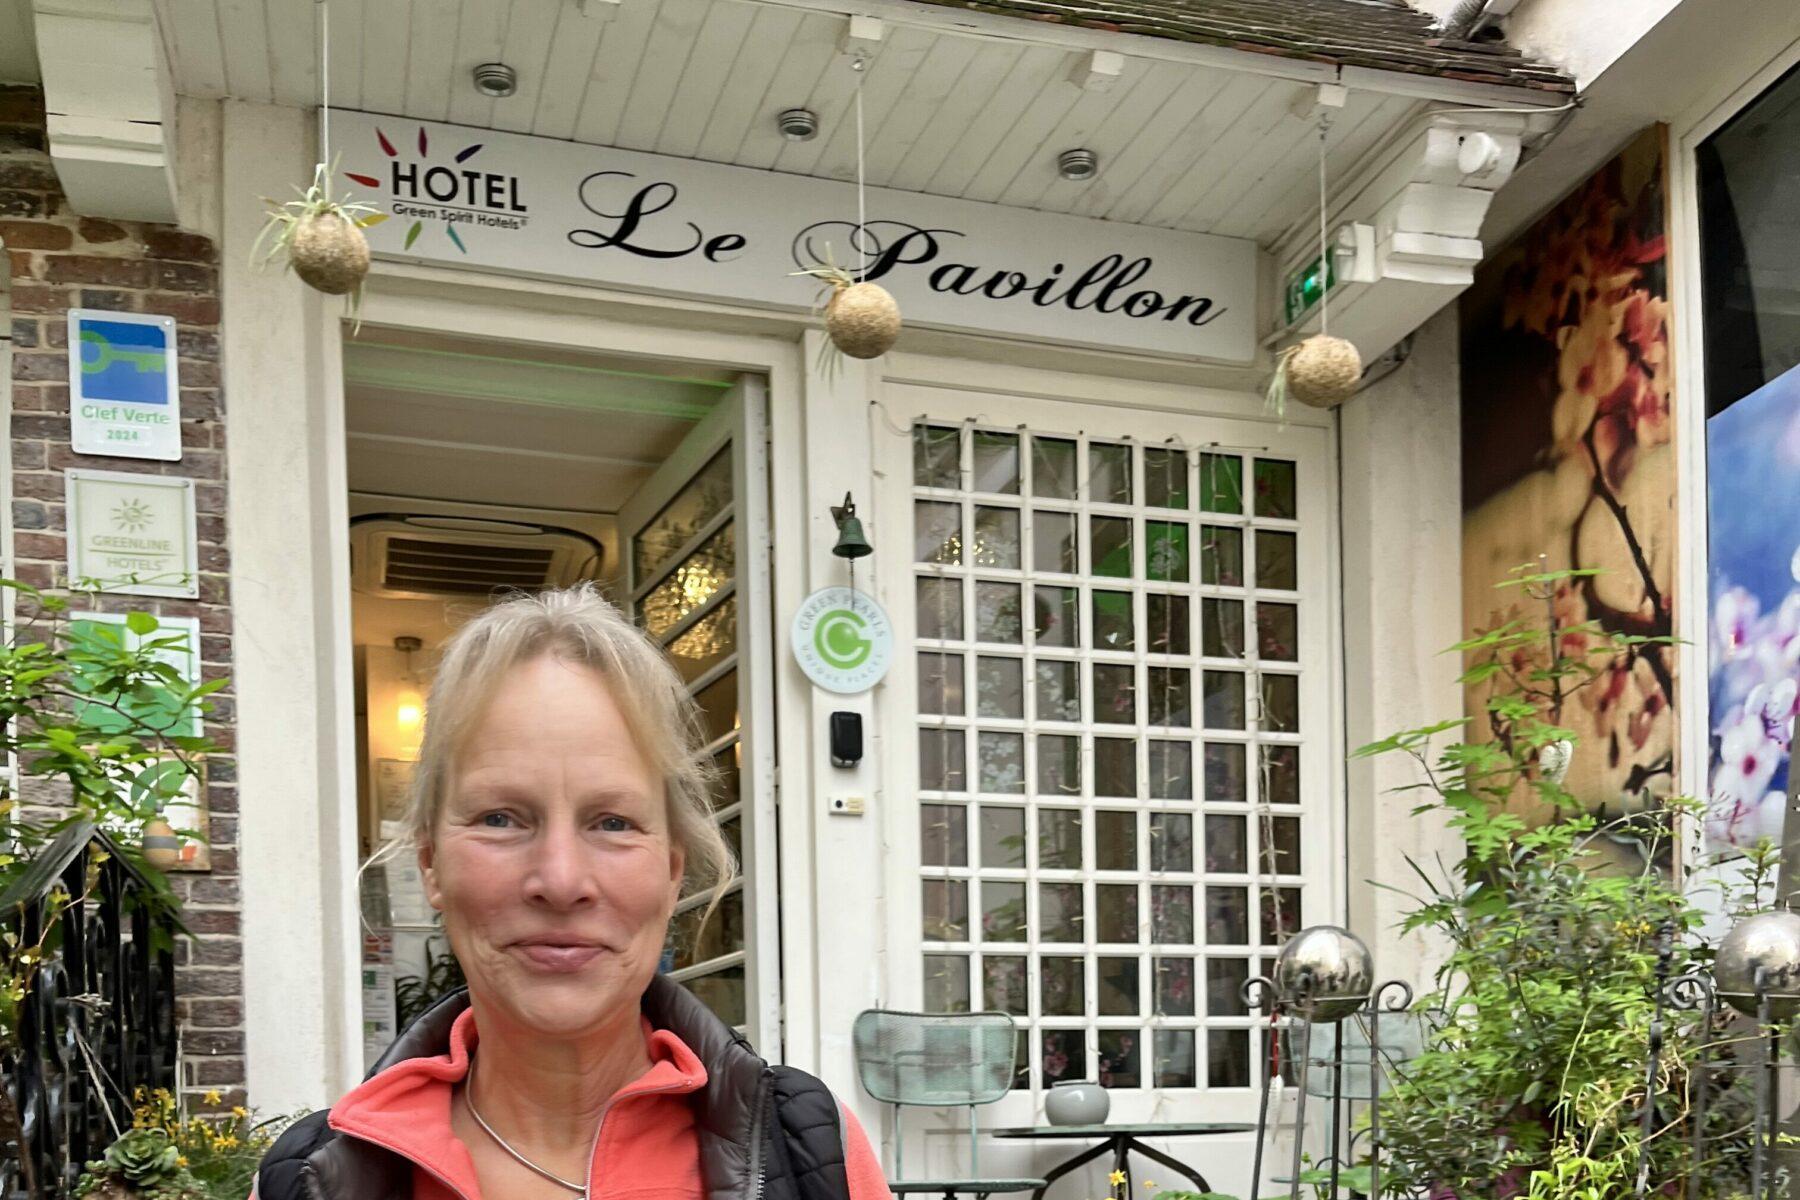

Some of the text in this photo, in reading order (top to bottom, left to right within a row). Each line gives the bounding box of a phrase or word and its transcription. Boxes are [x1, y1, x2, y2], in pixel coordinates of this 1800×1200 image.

[392, 161, 527, 212] HOTEL
[392, 203, 437, 219] Green
[440, 209, 474, 225] Spirit
[568, 171, 1228, 326] Le Pavillon
[81, 404, 171, 425] Clef Verte
[106, 429, 140, 441] 2024
[92, 535, 172, 551] GREENLINE
[106, 557, 162, 571] HOTELS
